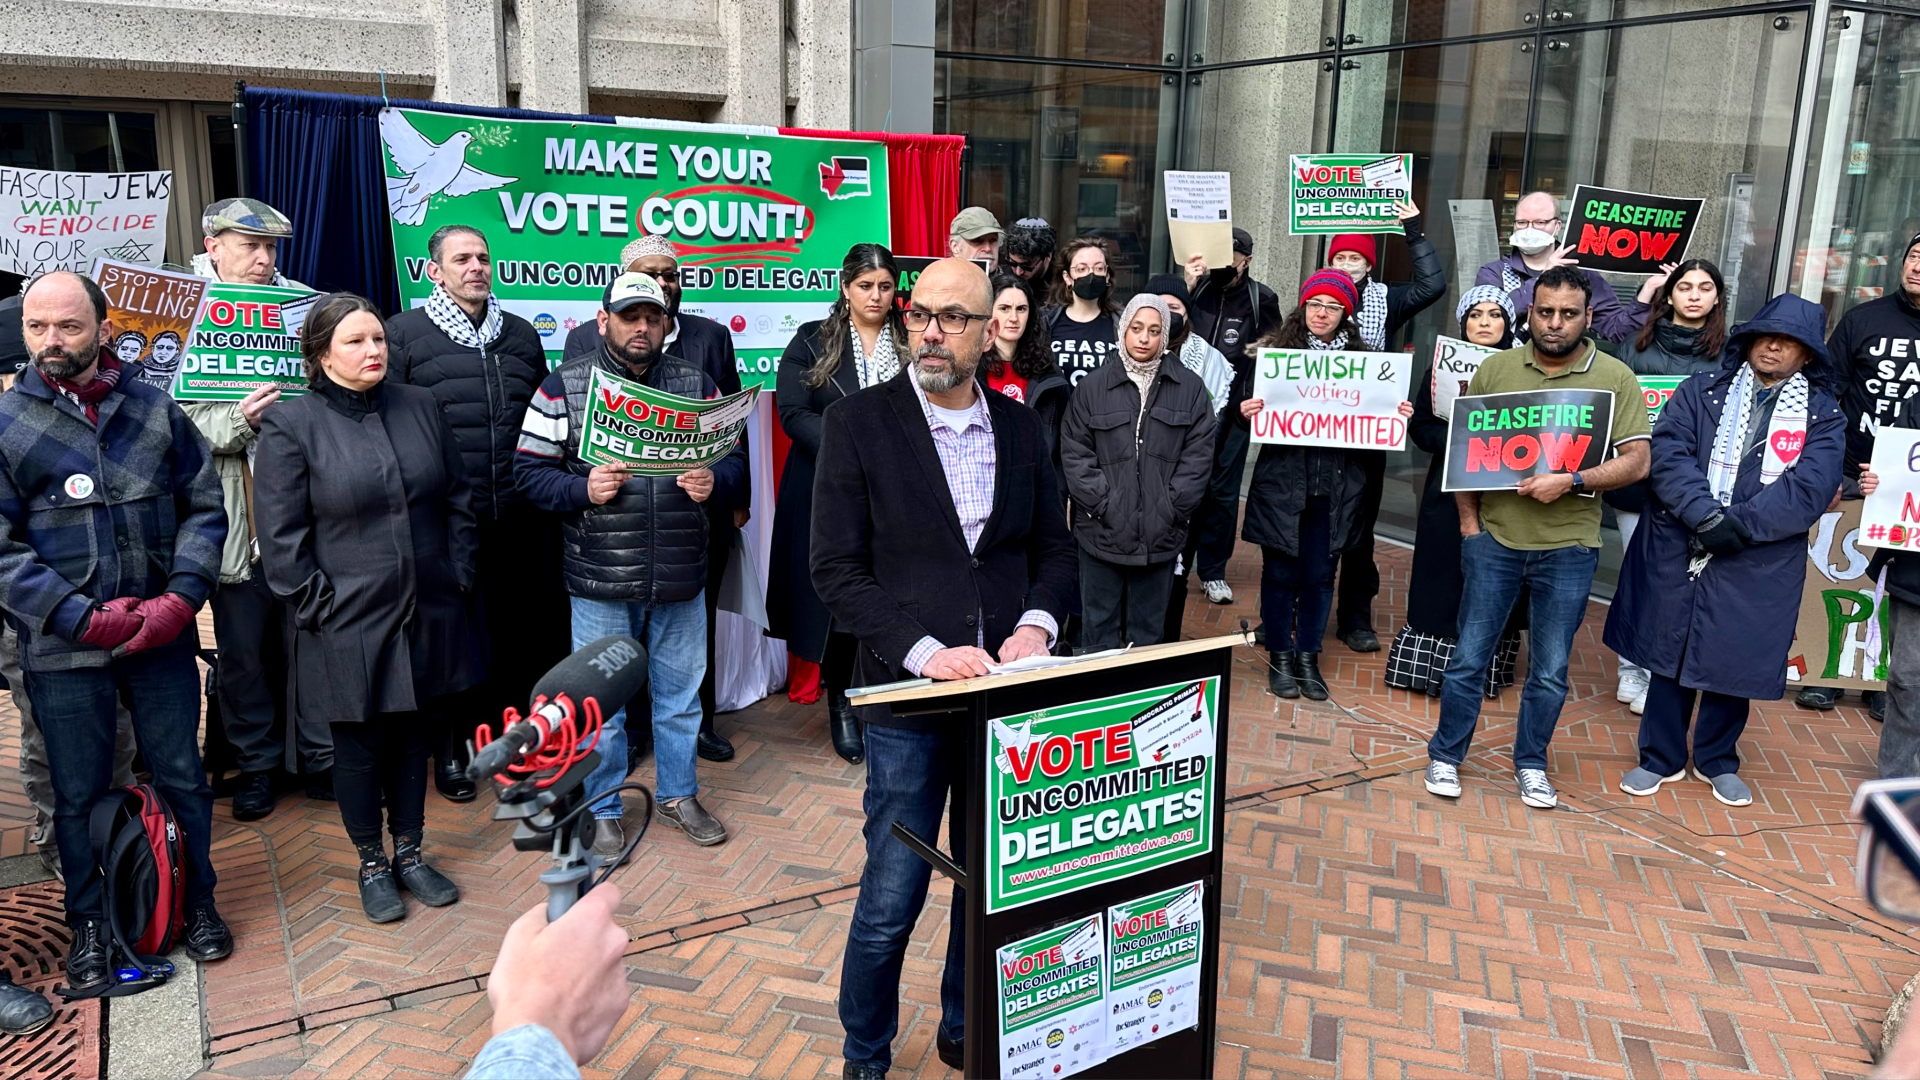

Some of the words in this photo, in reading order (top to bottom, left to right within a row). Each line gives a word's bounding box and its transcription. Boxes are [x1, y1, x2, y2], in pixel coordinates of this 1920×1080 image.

[544, 137, 659, 177] MAKE
[669, 143, 772, 182] YOUR
[1299, 167, 1362, 183] VOTE
[0, 169, 91, 200] FASCIST
[104, 173, 171, 200] JEWS
[1296, 188, 1404, 198] UNCOMMITTED
[21, 200, 102, 216] WANT
[498, 191, 628, 233] VOTE
[640, 198, 807, 239] COUNT!
[1297, 202, 1401, 216] DELEGATES
[1585, 200, 1687, 228] CEASEFIRE
[14, 214, 157, 236] GENOCIDE
[34, 240, 86, 261] OUR
[1577, 223, 1680, 261] NOW
[105, 268, 158, 288] STOP
[165, 280, 201, 297] THE
[499, 261, 714, 290] UNCOMED
[722, 267, 838, 290] DELEGAT
[101, 281, 195, 318] KILLING
[191, 331, 303, 351] NCOMMIT
[534, 321, 557, 329] 3000
[182, 353, 305, 377] DELEGAT
[1264, 352, 1367, 380] JEWISH
[1377, 361, 1396, 383] &
[602, 387, 699, 430] VOTE
[1297, 382, 1360, 407] voting
[592, 409, 745, 444] UNCOMMITTED
[1254, 410, 1405, 447] UNCOMMITTED
[1468, 404, 1594, 431] CEASEFIRE
[590, 428, 740, 461] DELEGATES
[1466, 432, 1592, 473] NOW
[1133, 700, 1173, 726] DEMOCRATIC
[1174, 683, 1200, 703] PRIMARY
[1006, 723, 1131, 782] VOTE
[999, 755, 1206, 822] UNCOMMITTED
[1001, 788, 1203, 868] DELEGATES
[1010, 828, 1194, 885] www.uncommittedwa.org
[1113, 921, 1198, 954] UNCOMMITTED
[1114, 909, 1166, 938] VOTE
[1003, 945, 1063, 979] VOTE
[1114, 936, 1197, 973] DELEGATES
[1004, 956, 1098, 997] UNCOMMITTED
[1006, 971, 1099, 1017] DELEGATES
[1120, 996, 1144, 1012] AMAC
[1016, 1037, 1042, 1054] AMAC
